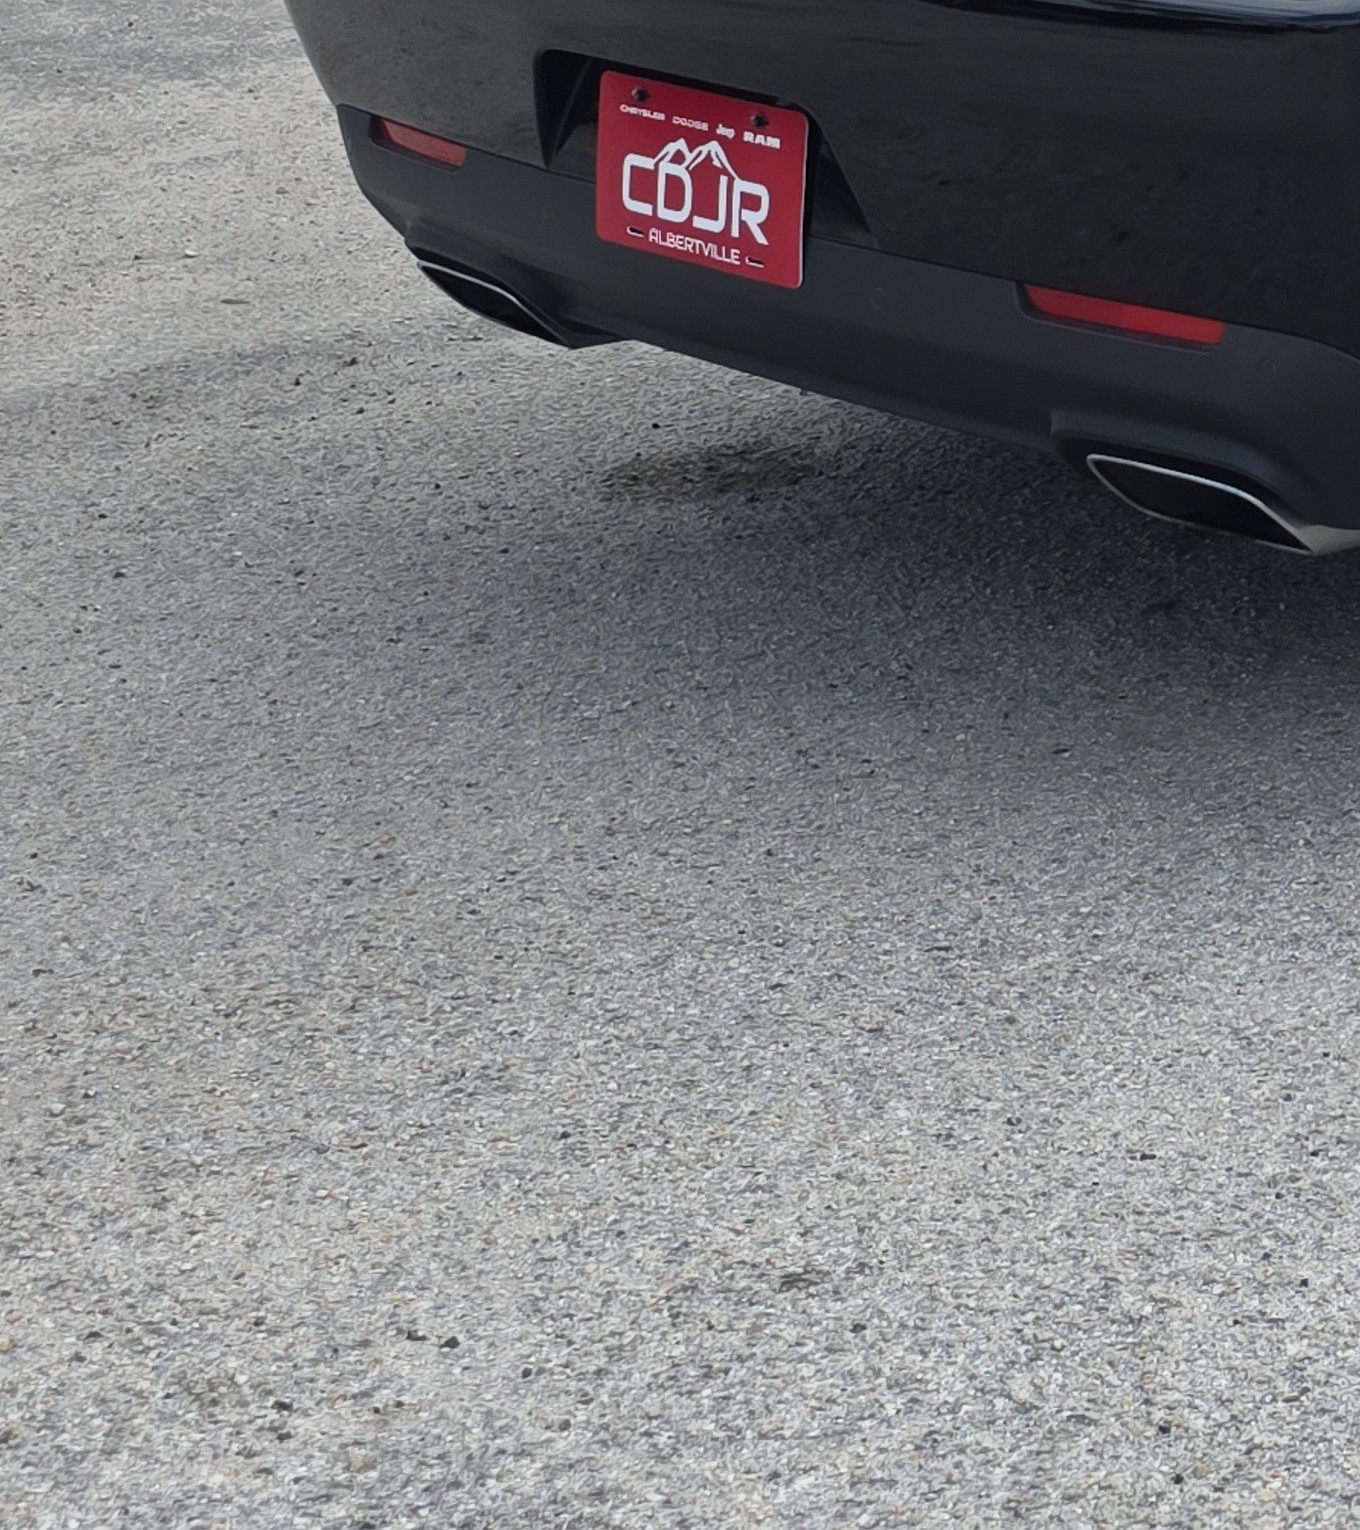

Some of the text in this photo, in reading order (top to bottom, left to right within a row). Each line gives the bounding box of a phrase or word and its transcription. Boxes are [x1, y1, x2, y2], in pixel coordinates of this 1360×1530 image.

[619, 103, 667, 121] CHRYSLER
[672, 115, 709, 131] DODGE
[743, 131, 781, 149] RAM
[622, 152, 770, 246] CDJR
[648, 227, 741, 265] ALBERTVILLE
